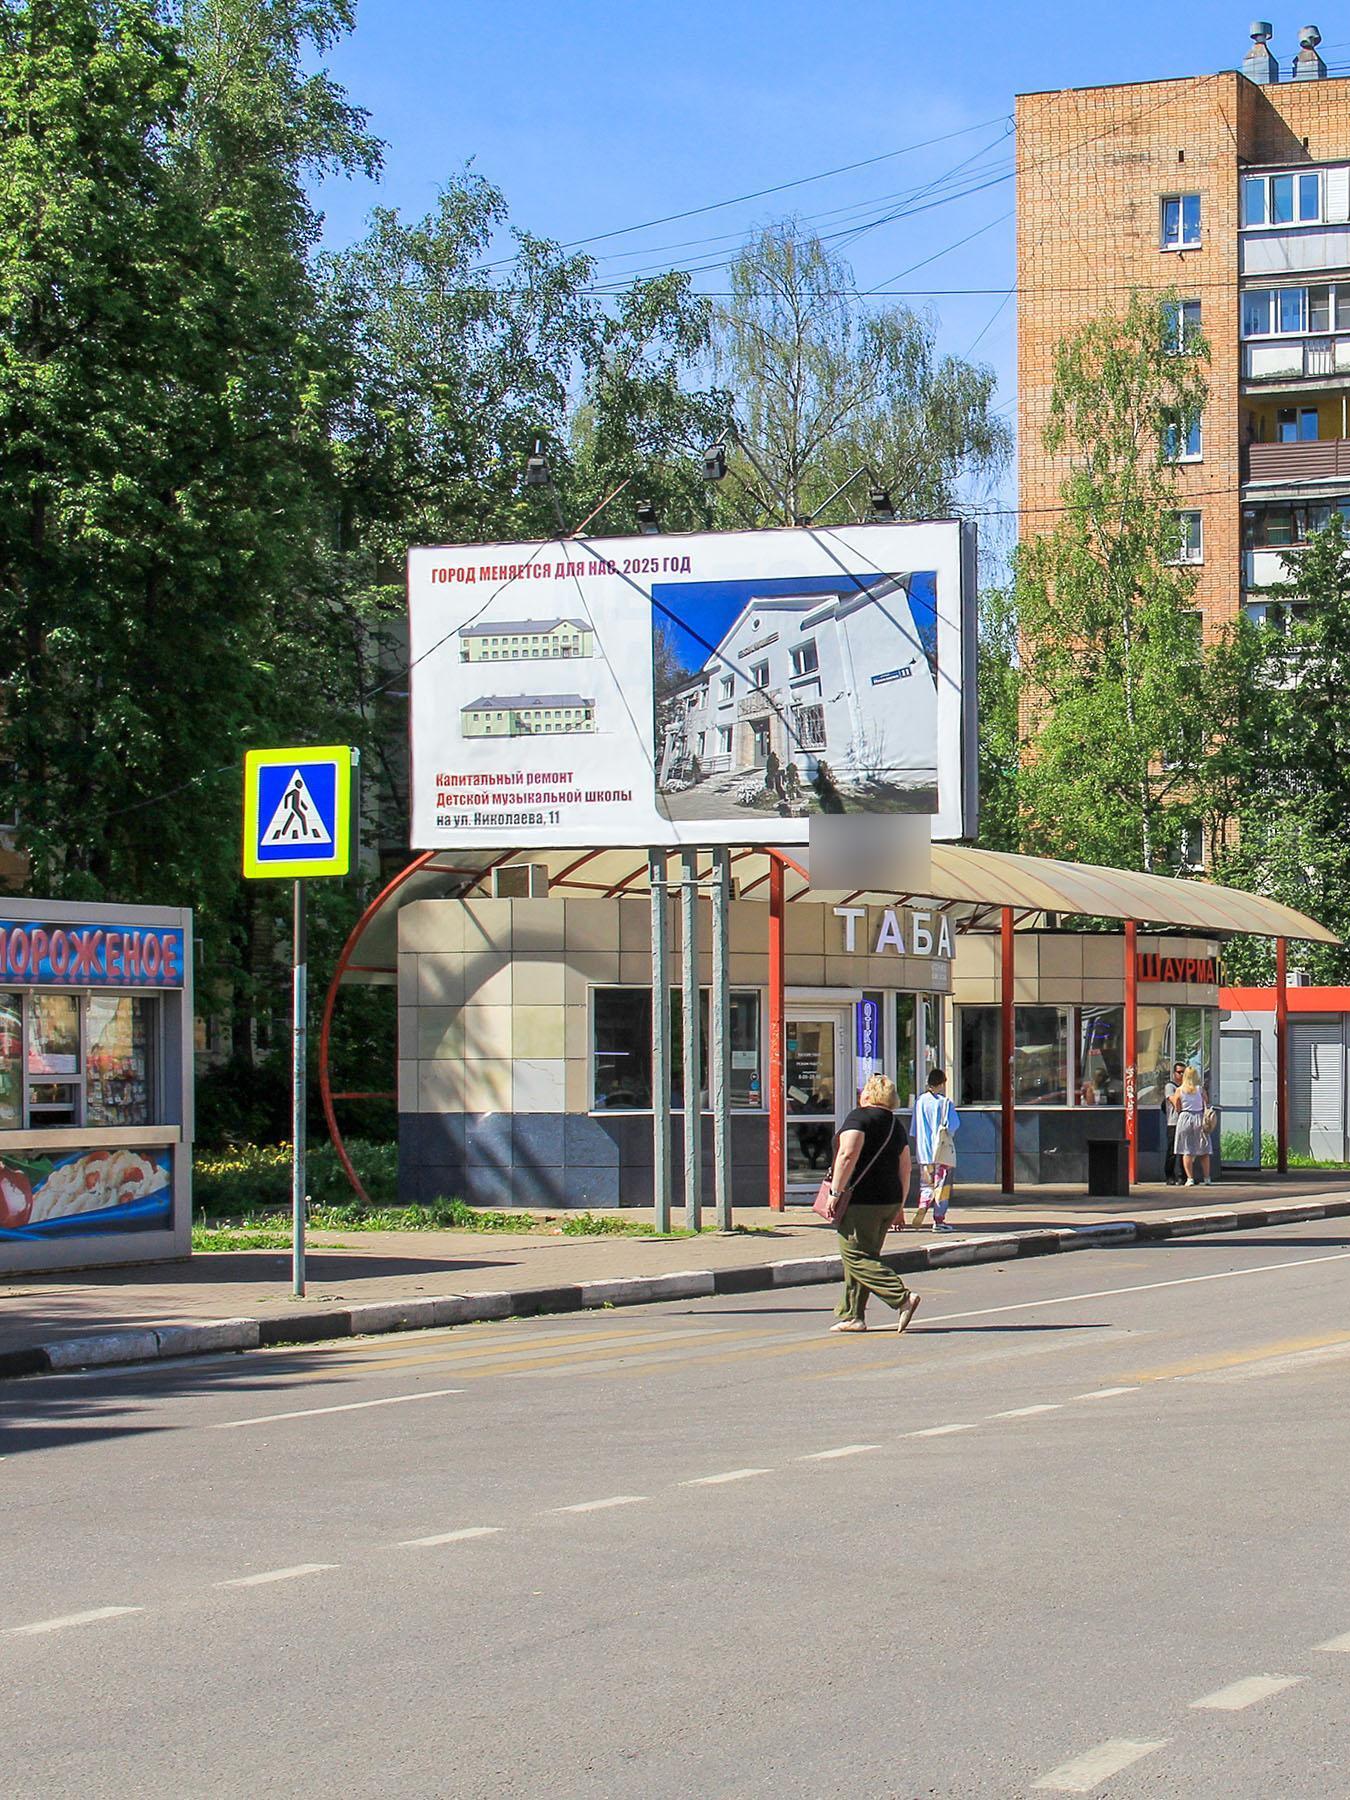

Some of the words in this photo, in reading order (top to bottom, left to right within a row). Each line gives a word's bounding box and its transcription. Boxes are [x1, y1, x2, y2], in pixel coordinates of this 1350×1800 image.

[431, 567, 476, 583] ГОРОД
[479, 563, 551, 581] МЕНЯЕТСЯ
[554, 561, 585, 580] ДЛЯ
[623, 557, 659, 574] 2025
[663, 555, 692, 573] ГОД
[435, 770, 524, 787] Капитальный
[526, 772, 574, 786] ремонт
[436, 790, 489, 808] Детской
[492, 788, 582, 806] музыкальной
[585, 789, 633, 803] школы
[436, 814, 451, 826] на
[453, 815, 472, 828] ул.
[474, 811, 546, 827] Николаева,
[549, 810, 560, 824] 11
[1137, 953, 1215, 984] ШАУРМА
